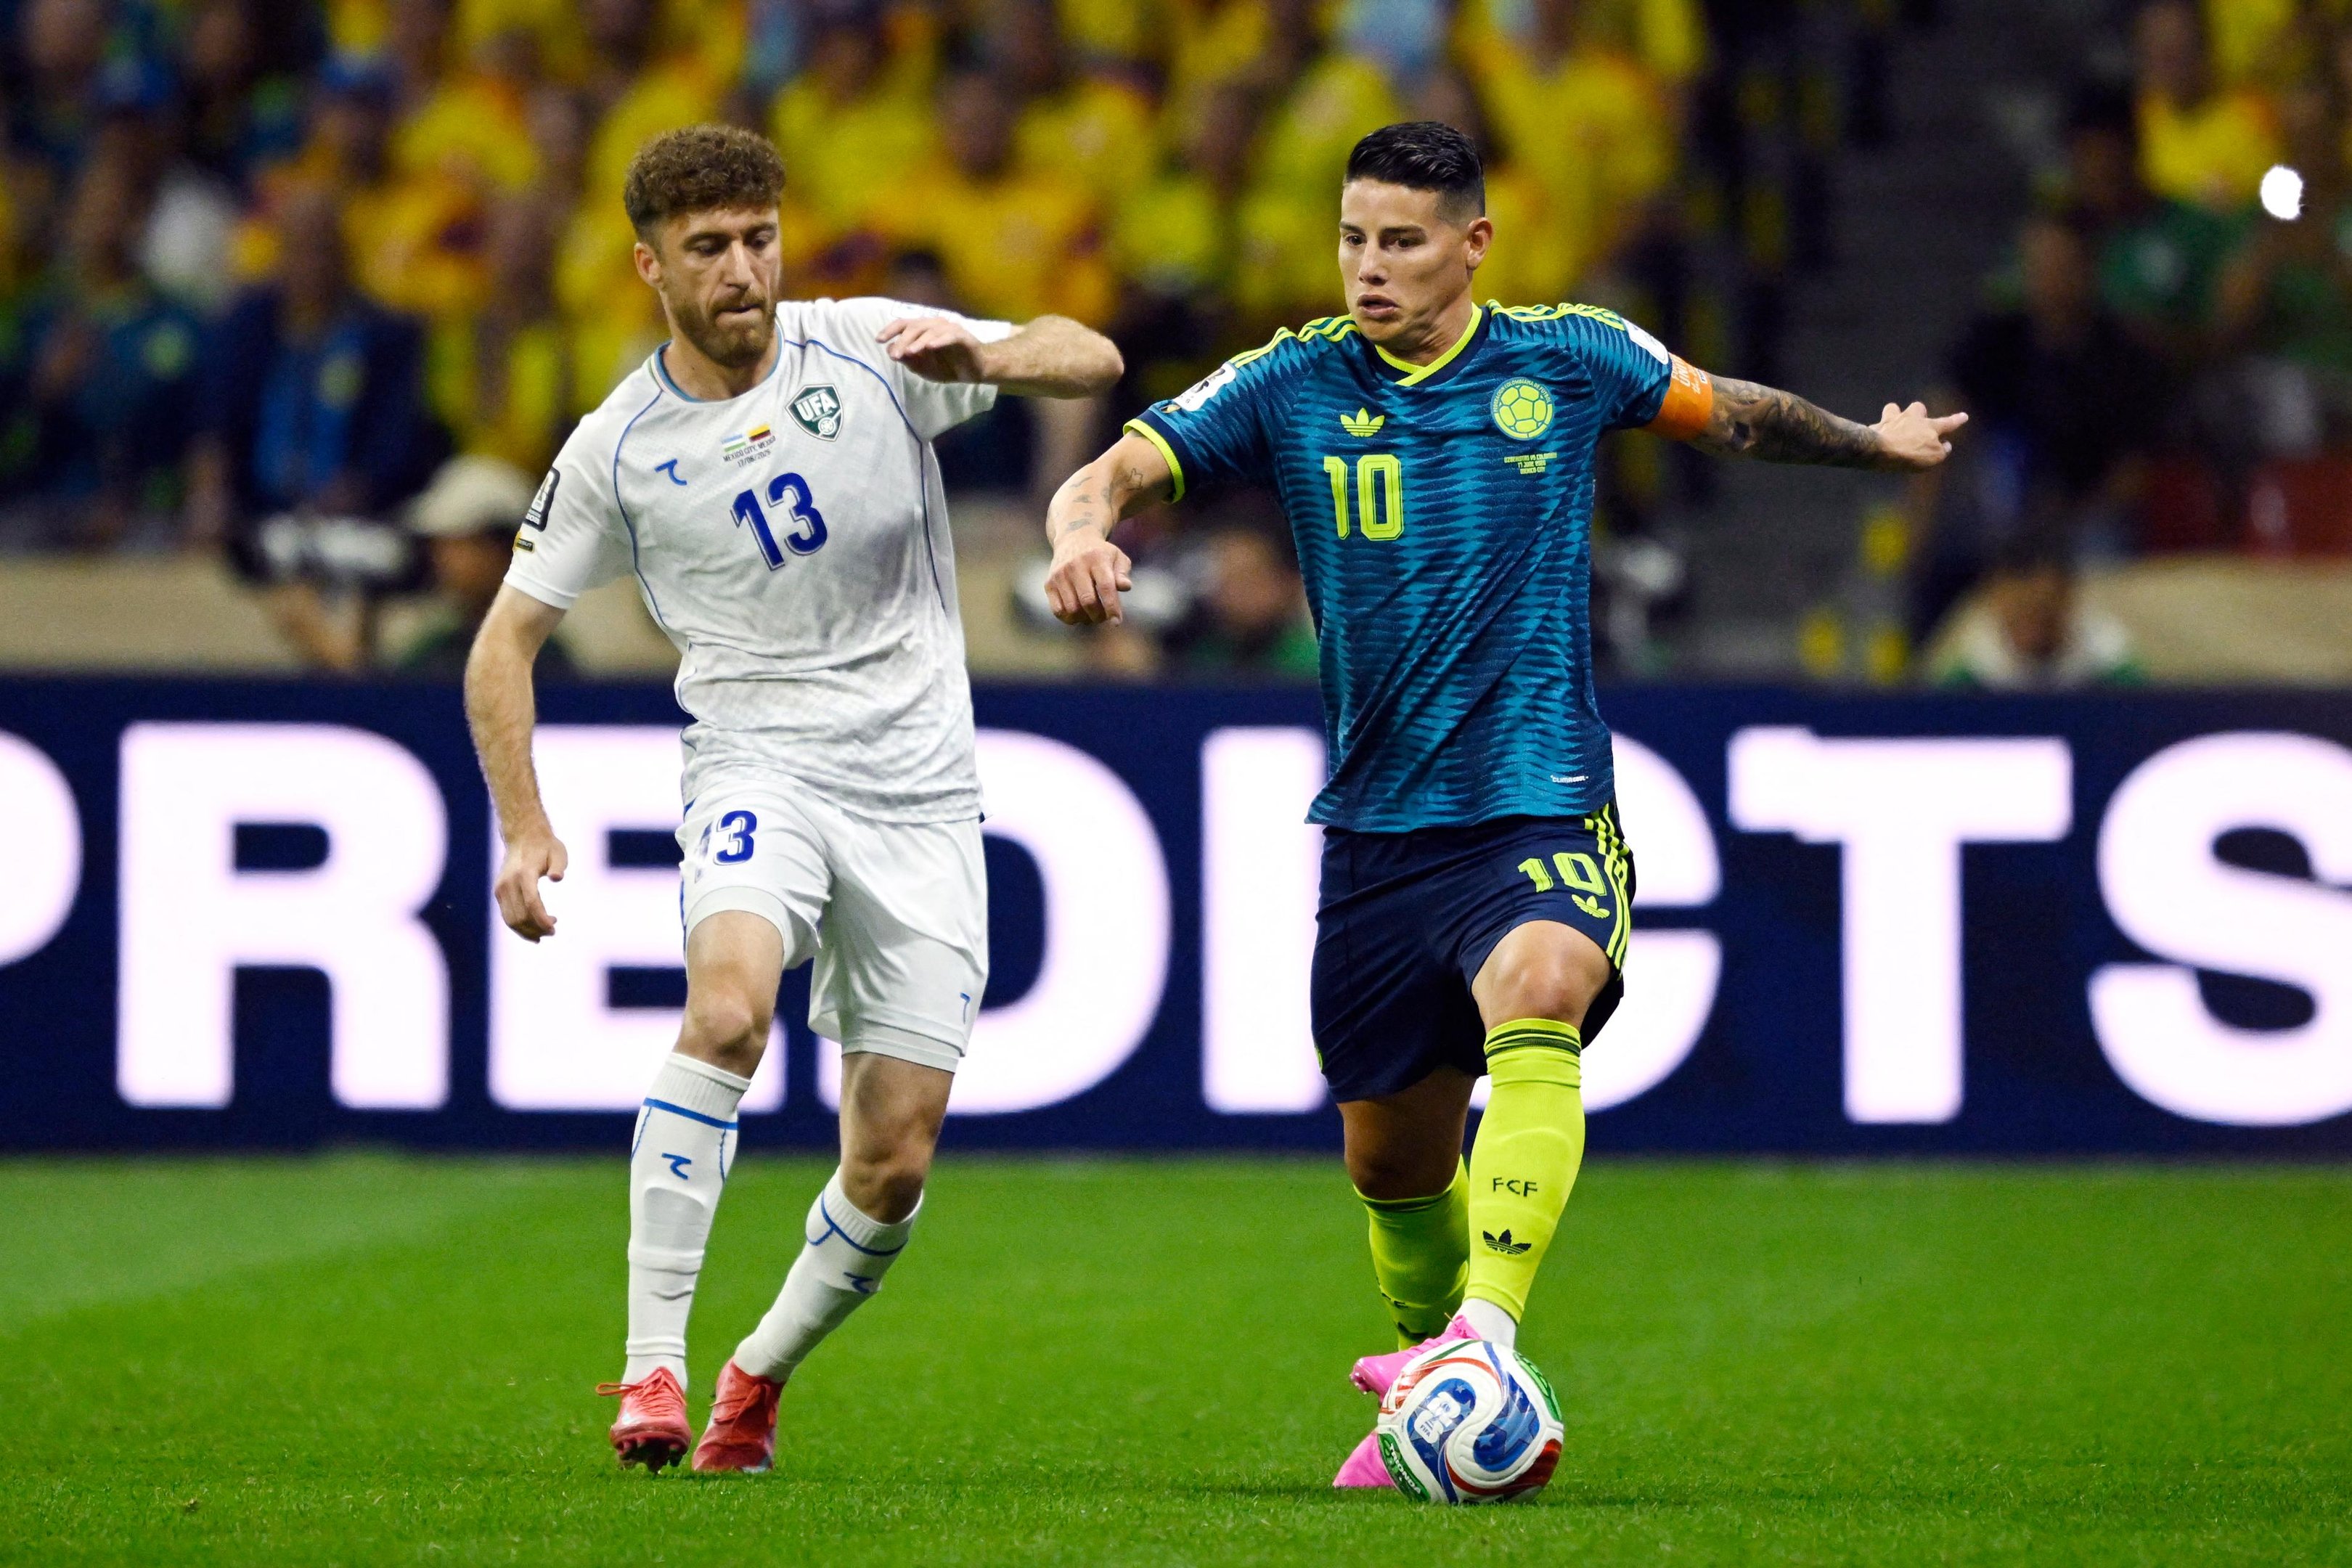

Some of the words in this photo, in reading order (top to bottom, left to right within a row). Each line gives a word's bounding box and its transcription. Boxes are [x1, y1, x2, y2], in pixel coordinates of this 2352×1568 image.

[796, 392, 838, 421] UFA
[730, 472, 828, 571] 13
[1323, 454, 1405, 542] 10
[1517, 852, 1608, 897] 10
[0, 722, 2352, 1125] REDITS
[1493, 1177, 1538, 1197] FCF
[1419, 1424, 1430, 1437] FIFA
[1389, 1443, 1421, 1495] TRIONDA
